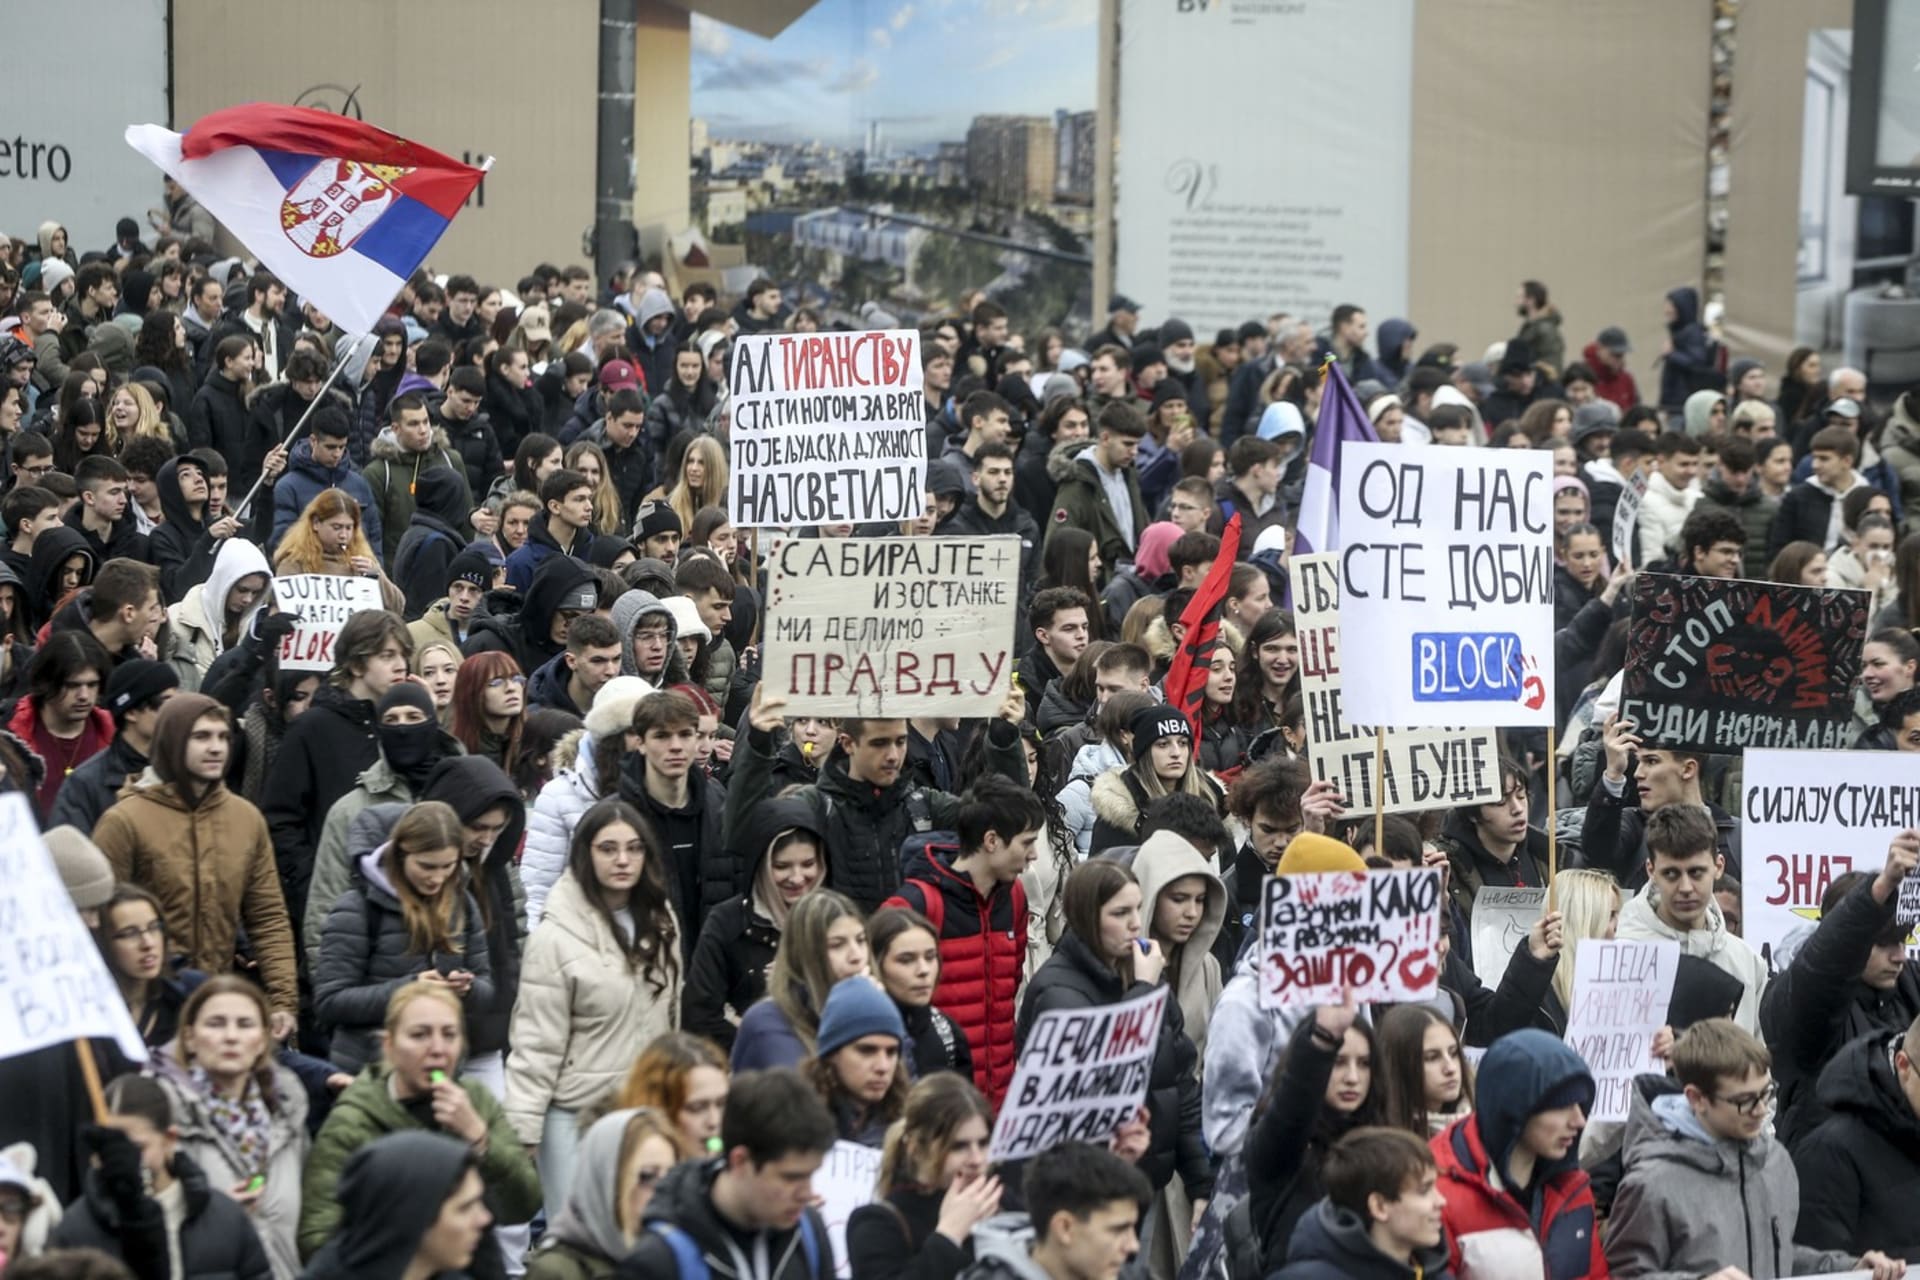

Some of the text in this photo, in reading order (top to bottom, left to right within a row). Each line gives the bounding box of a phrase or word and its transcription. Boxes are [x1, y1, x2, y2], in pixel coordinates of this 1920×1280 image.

[779, 333, 912, 391] ТИРАНСТВУ
[735, 397, 798, 430] СТАТИ
[801, 394, 857, 424] НОГОМ
[886, 390, 922, 421] ВРАТ
[735, 439, 757, 470] ТО
[785, 432, 850, 464] ЉУДСКА
[853, 428, 924, 460] ДУЖНОСТ
[1358, 459, 1424, 528] ОД
[1454, 467, 1546, 534] НАС
[780, 541, 985, 577] САБИРАЈТЕ
[1343, 543, 1426, 602] СТЕ
[873, 580, 1008, 609] ИЗОСТАНКЕ
[281, 629, 335, 662] BLOK
[776, 617, 811, 642] МИ
[824, 617, 923, 642] ДЕЛИМО
[1653, 599, 1735, 690] СТОП
[789, 650, 1007, 697] ПРАВДУ
[1419, 636, 1518, 695] BLOCK
[1157, 719, 1190, 736] NBA
[1621, 699, 1853, 749] БУДИ НОРМАЛАН
[1409, 737, 1493, 801] БУДЕ
[1747, 785, 1832, 824] СИЈАЈУ
[1370, 872, 1440, 921] КАКО
[1589, 944, 1659, 984] ДЕЦА
[1021, 1014, 1113, 1068] ДЕЦА
